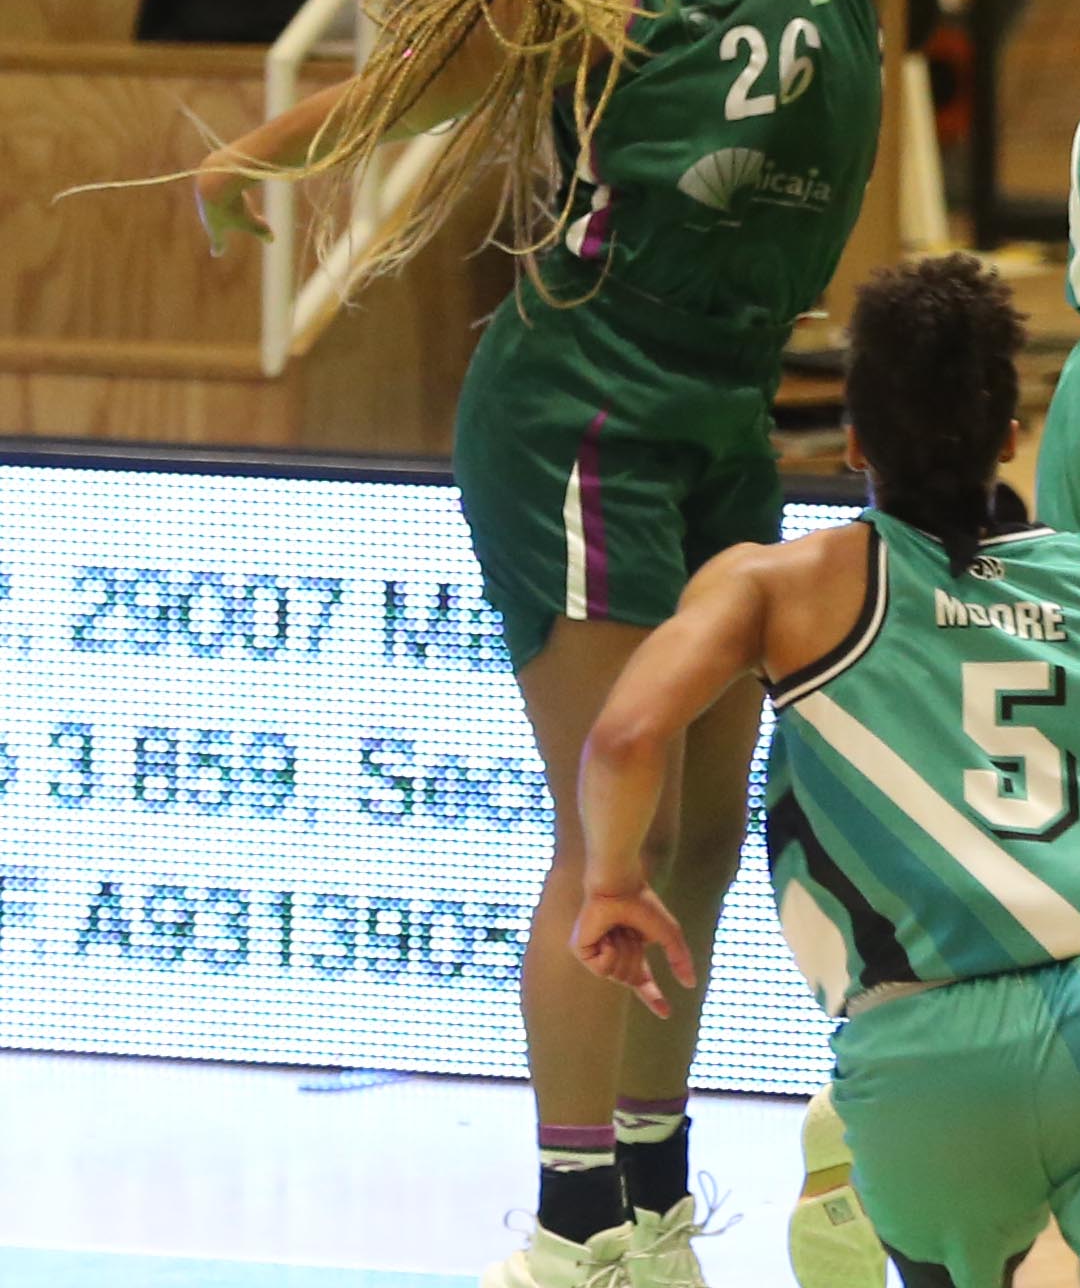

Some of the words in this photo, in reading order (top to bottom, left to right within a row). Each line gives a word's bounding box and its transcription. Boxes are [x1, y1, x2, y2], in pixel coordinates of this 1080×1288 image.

[720, 17, 821, 121] 26
[934, 588, 1067, 642] MOORE
[962, 661, 1079, 842] 5
